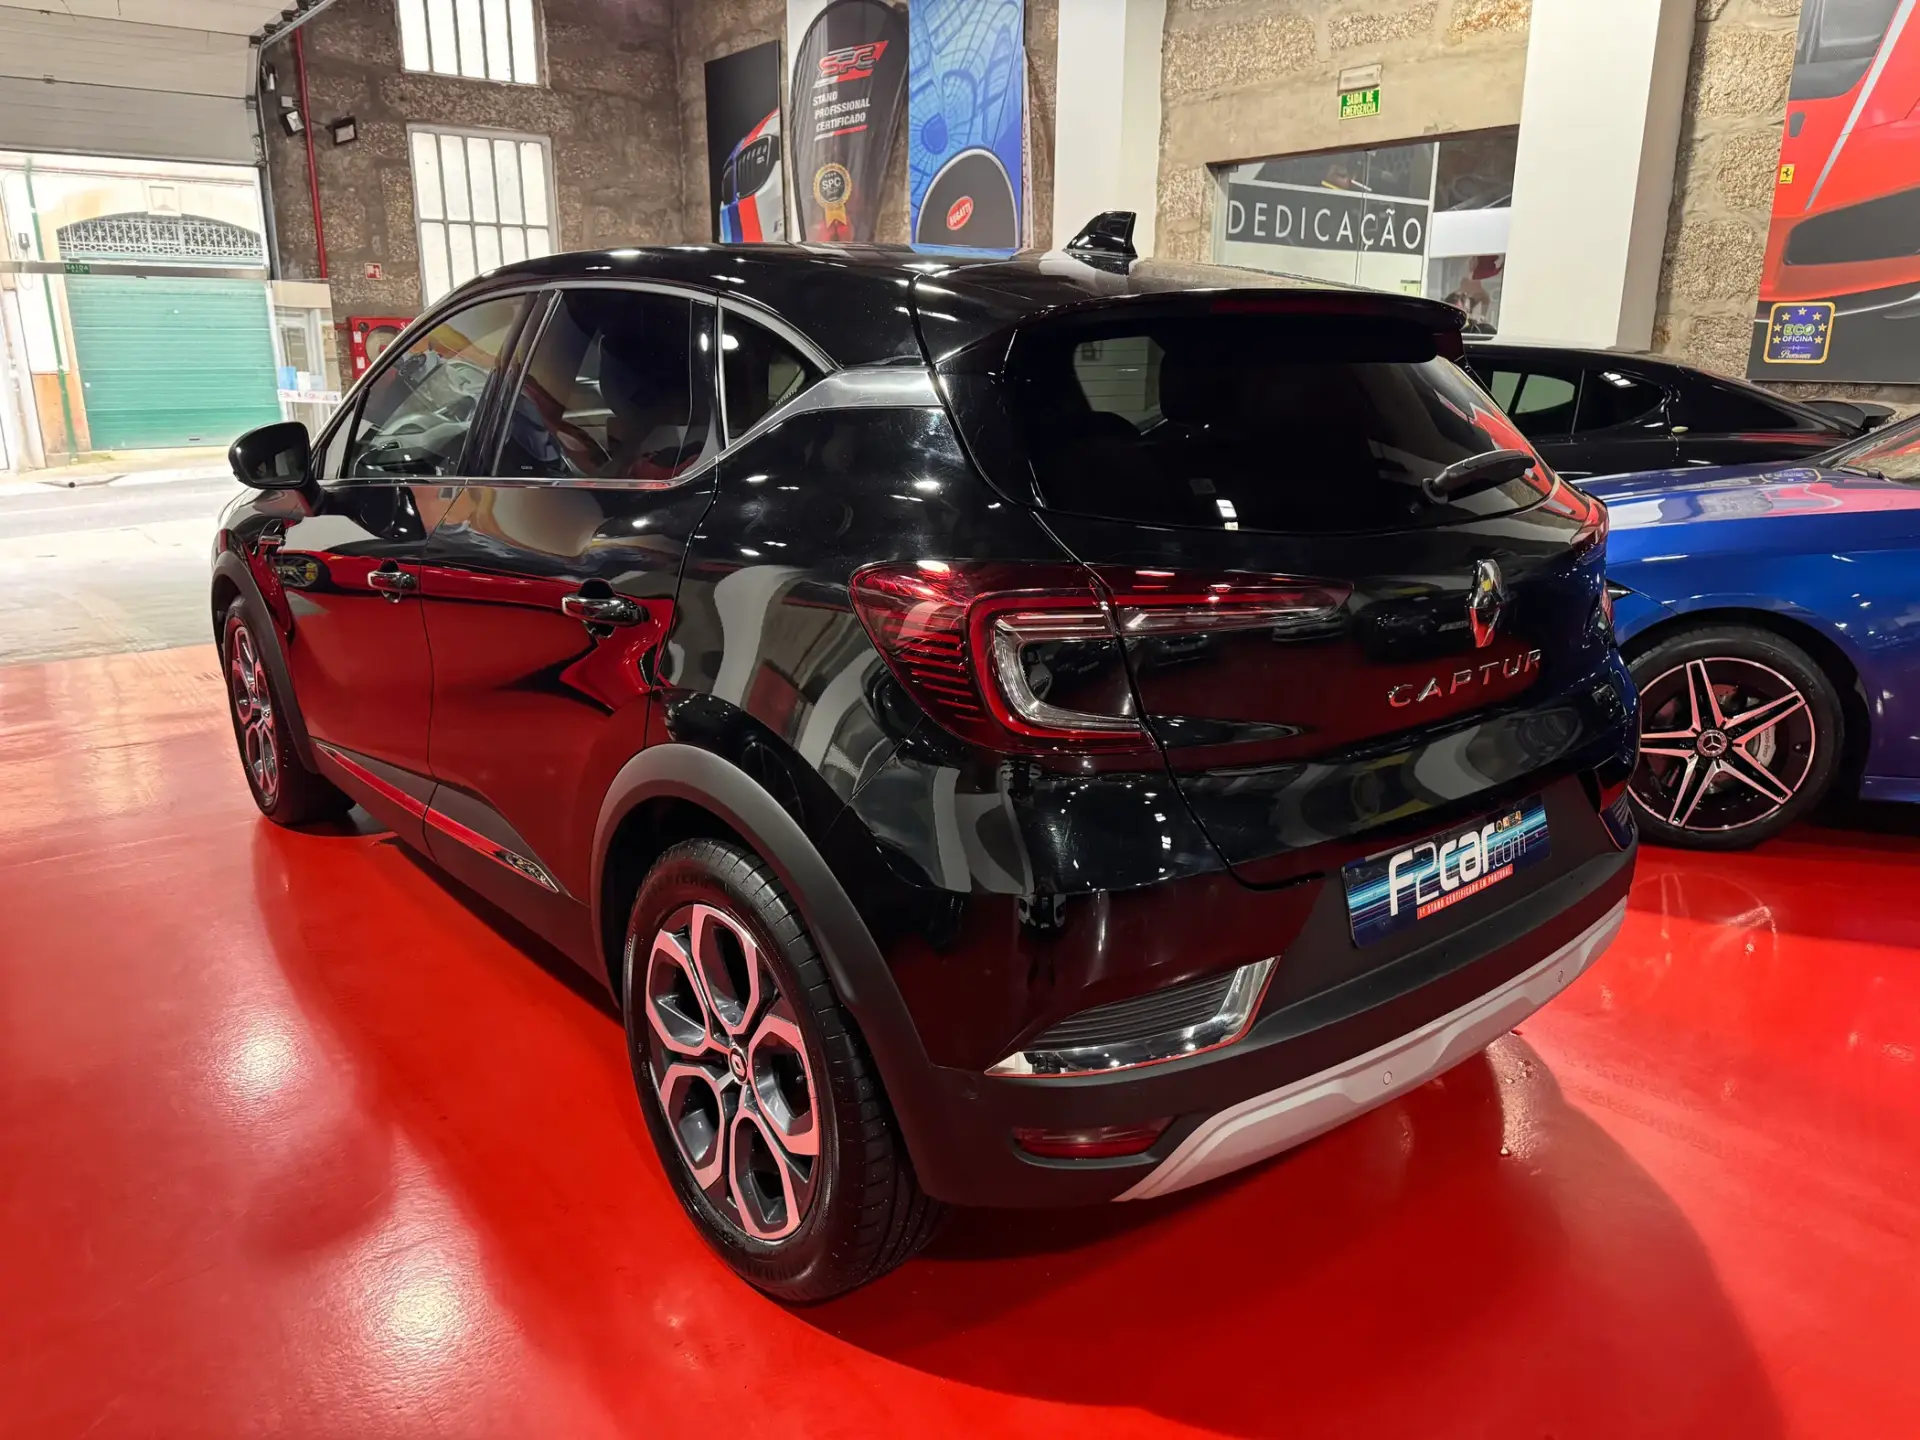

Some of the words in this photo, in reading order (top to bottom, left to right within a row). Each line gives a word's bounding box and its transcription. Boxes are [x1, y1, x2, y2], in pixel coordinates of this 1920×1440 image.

[812, 91, 838, 106] STAND
[1366, 91, 1375, 102] DE
[814, 98, 871, 120] PROFISSIONAL
[816, 112, 866, 132] CERTIFICADO
[821, 177, 842, 190] SPC
[949, 201, 971, 226] BUGATTI
[1228, 200, 1422, 251] DEDICAÇÃO
[1783, 323, 1815, 336] ECO
[1387, 648, 1541, 707] CAPTUR
[1427, 897, 1445, 914] STAND
[1446, 880, 1479, 906] CERTIFICADO
